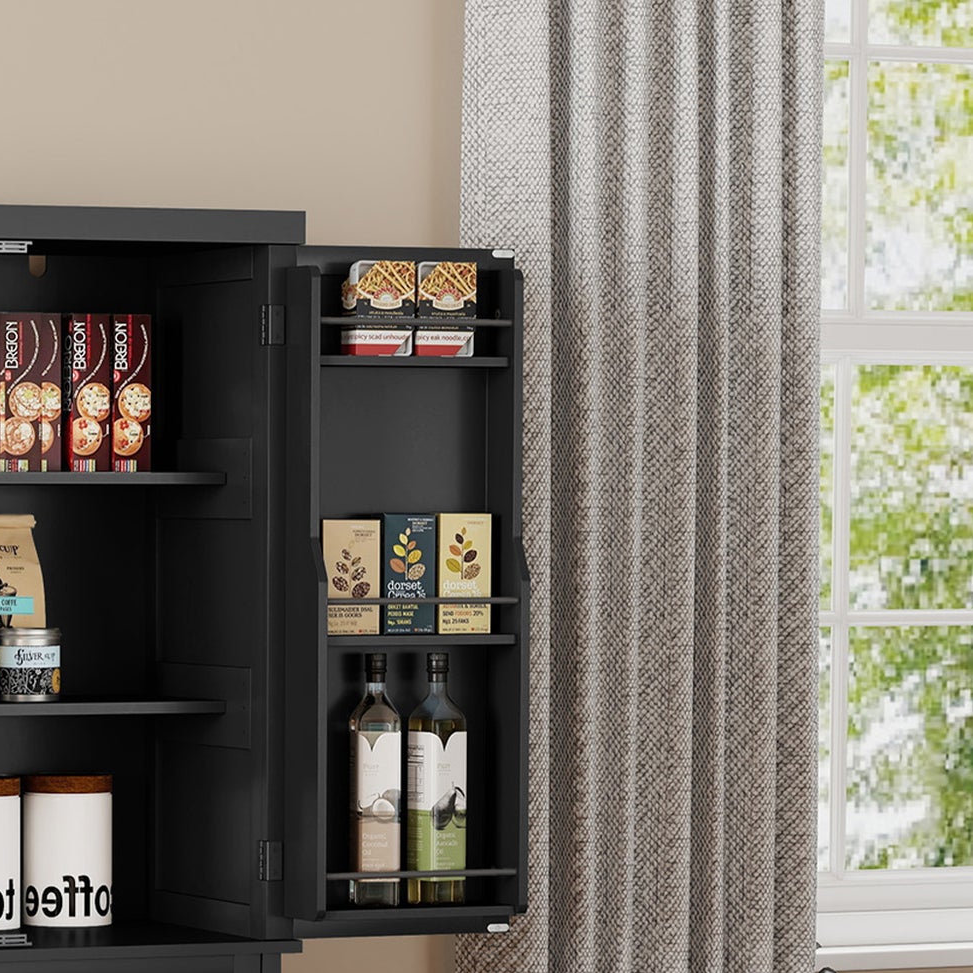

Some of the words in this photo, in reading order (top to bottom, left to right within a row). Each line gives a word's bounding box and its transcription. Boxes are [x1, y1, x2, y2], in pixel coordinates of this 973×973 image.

[387, 580, 423, 590] dorset
[443, 579, 477, 590] dorset
[13, 649, 42, 666] SILVER
